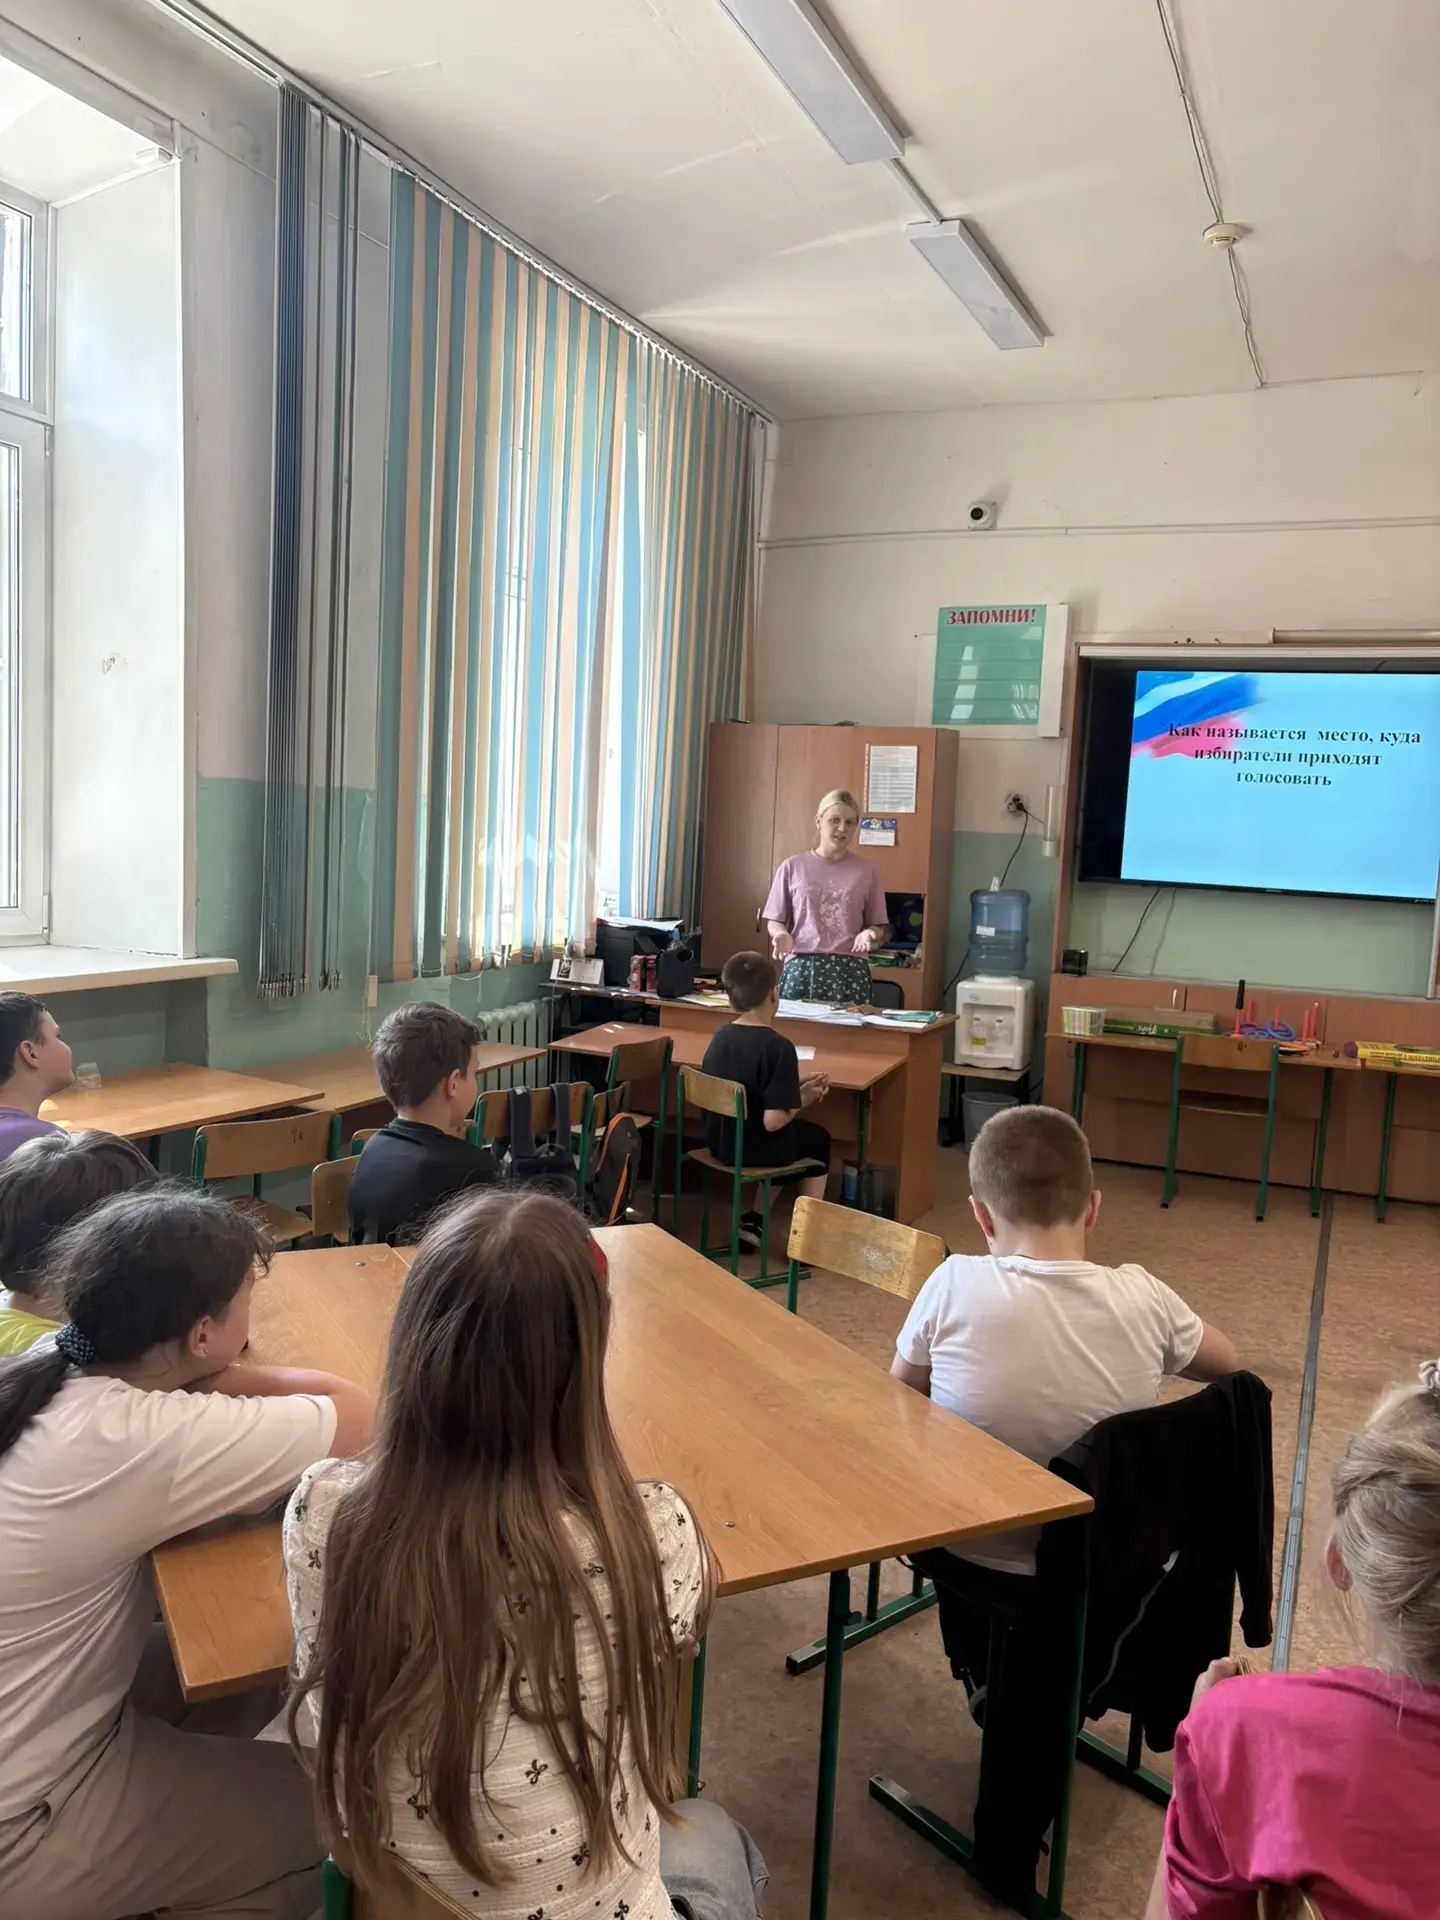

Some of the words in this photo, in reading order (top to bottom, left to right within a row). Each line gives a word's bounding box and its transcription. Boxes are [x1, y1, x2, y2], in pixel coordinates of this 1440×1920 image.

[946, 608, 1036, 625] ЗАПОМНИ!
[1168, 723, 1202, 737] Как
[1206, 727, 1306, 740] называется
[1317, 730, 1374, 744] место,
[1380, 732, 1421, 747] куда
[1195, 746, 1292, 764] избиратели
[1298, 753, 1382, 767] приходят
[1236, 772, 1332, 786] голосовать
